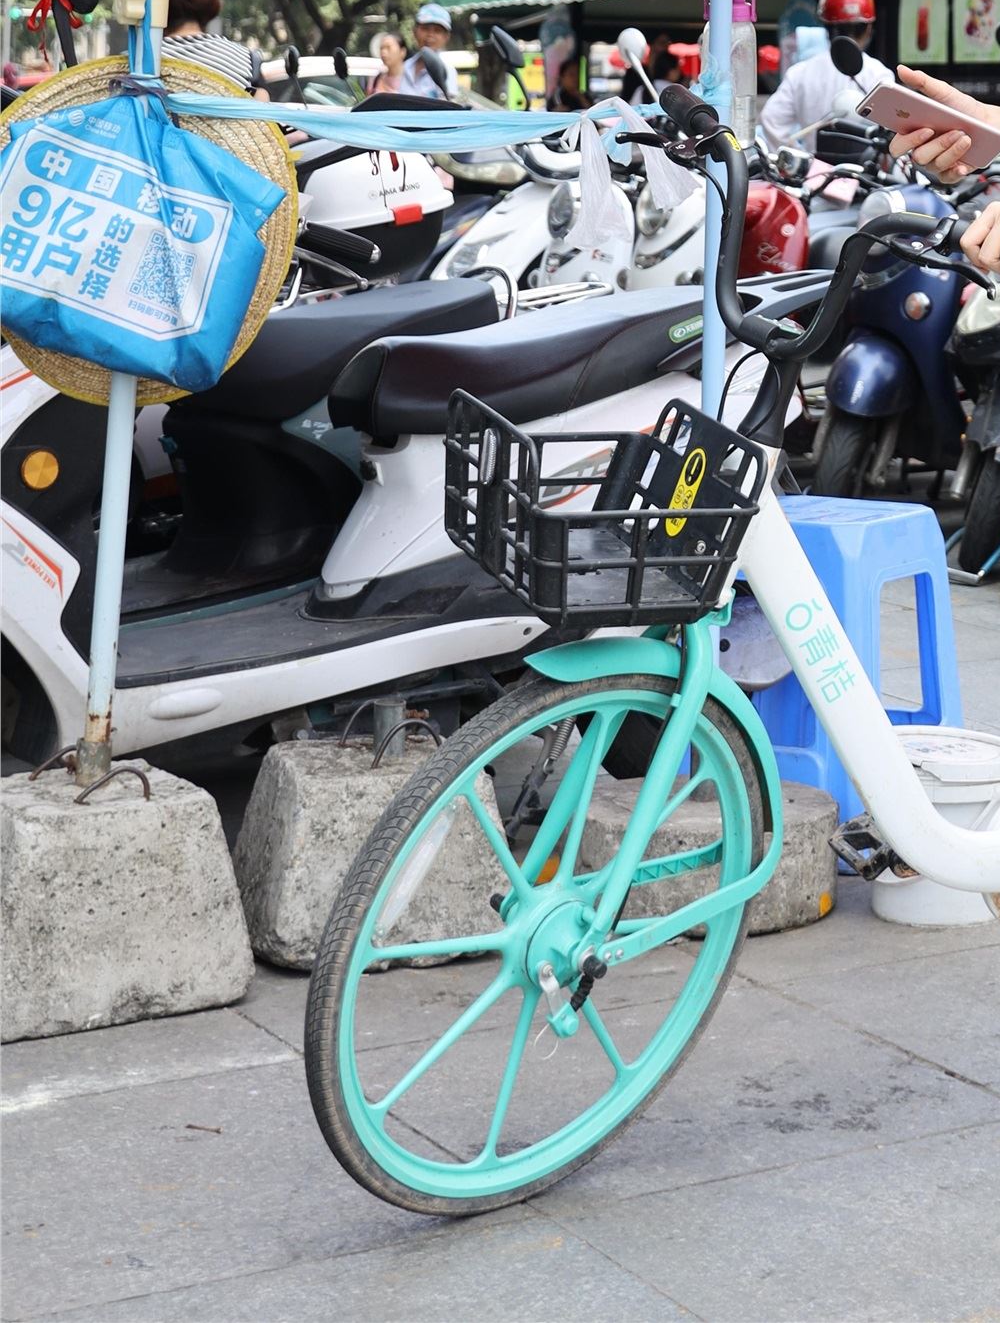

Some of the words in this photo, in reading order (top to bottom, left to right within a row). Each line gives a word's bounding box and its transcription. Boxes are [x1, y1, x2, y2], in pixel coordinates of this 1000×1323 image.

[12, 184, 96, 243] 9亿
[40, 148, 198, 240] 中国移动
[0, 223, 83, 278] 用户
[799, 623, 856, 704] 青桔
